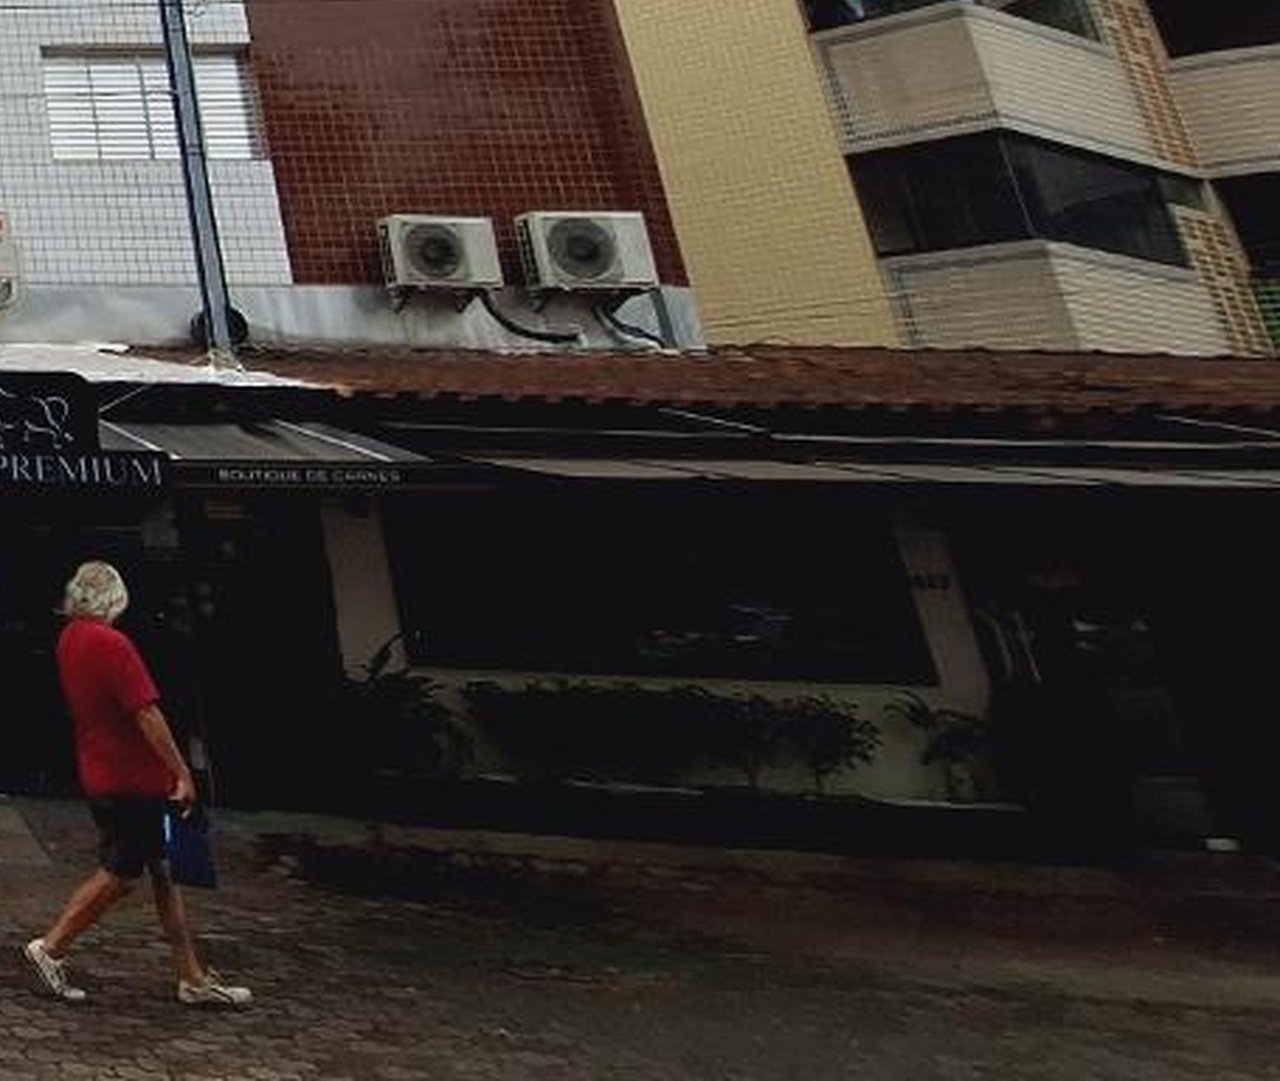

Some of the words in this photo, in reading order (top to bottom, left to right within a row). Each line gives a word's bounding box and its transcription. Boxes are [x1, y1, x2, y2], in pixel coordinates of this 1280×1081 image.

[218, 469, 302, 482] BOUTIQUE
[305, 469, 328, 482] DE
[331, 469, 401, 483] CARNES
